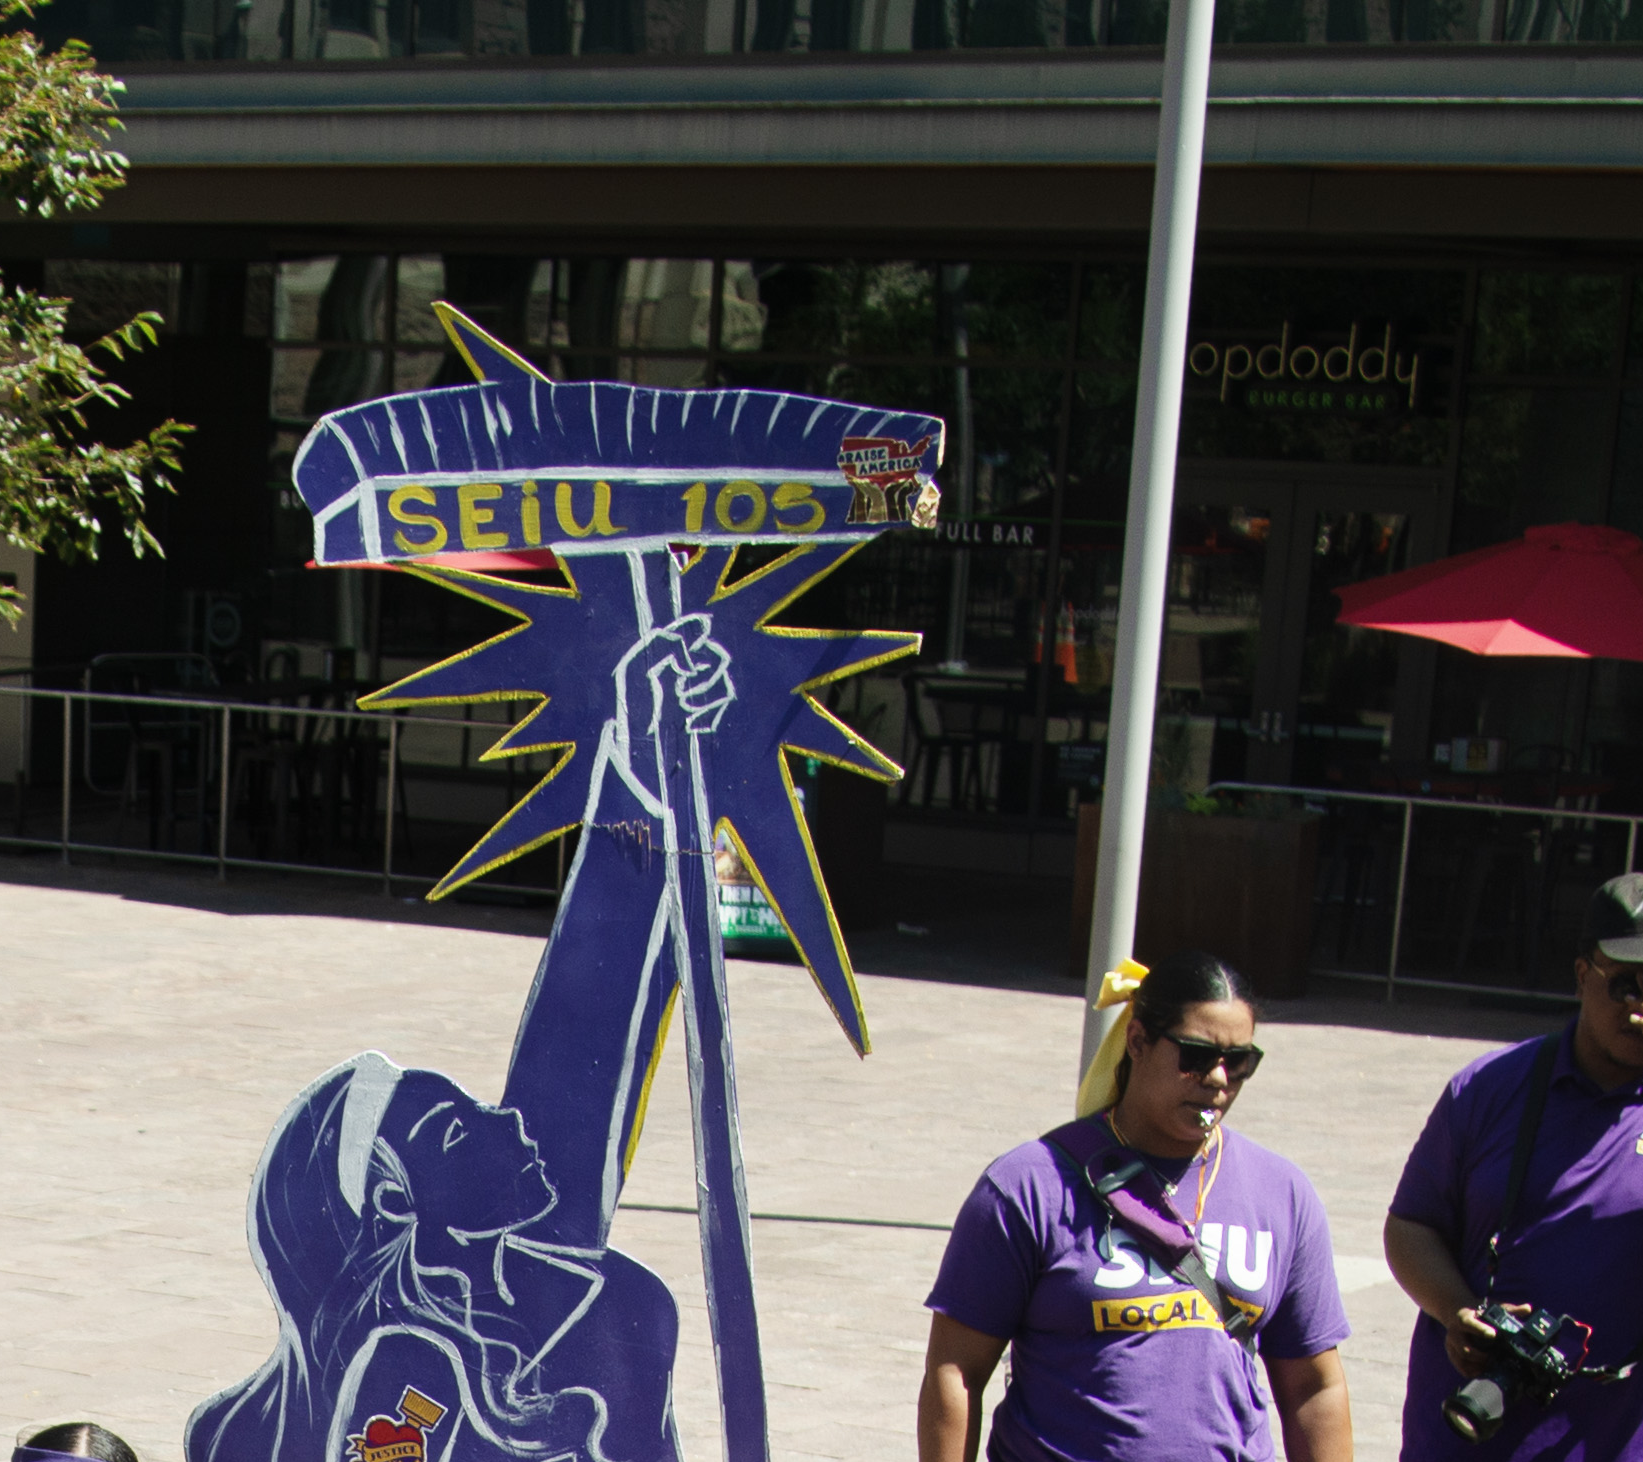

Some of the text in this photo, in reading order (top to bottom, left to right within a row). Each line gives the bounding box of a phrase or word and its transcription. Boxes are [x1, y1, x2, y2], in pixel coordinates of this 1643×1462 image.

[1189, 320, 1417, 407] opdoddy
[857, 456, 922, 474] AMERICA
[681, 480, 827, 533] 105
[932, 522, 1035, 545] FULL BAR
[1093, 1221, 1272, 1294] SIU
[1099, 1295, 1206, 1329] LOCAL
